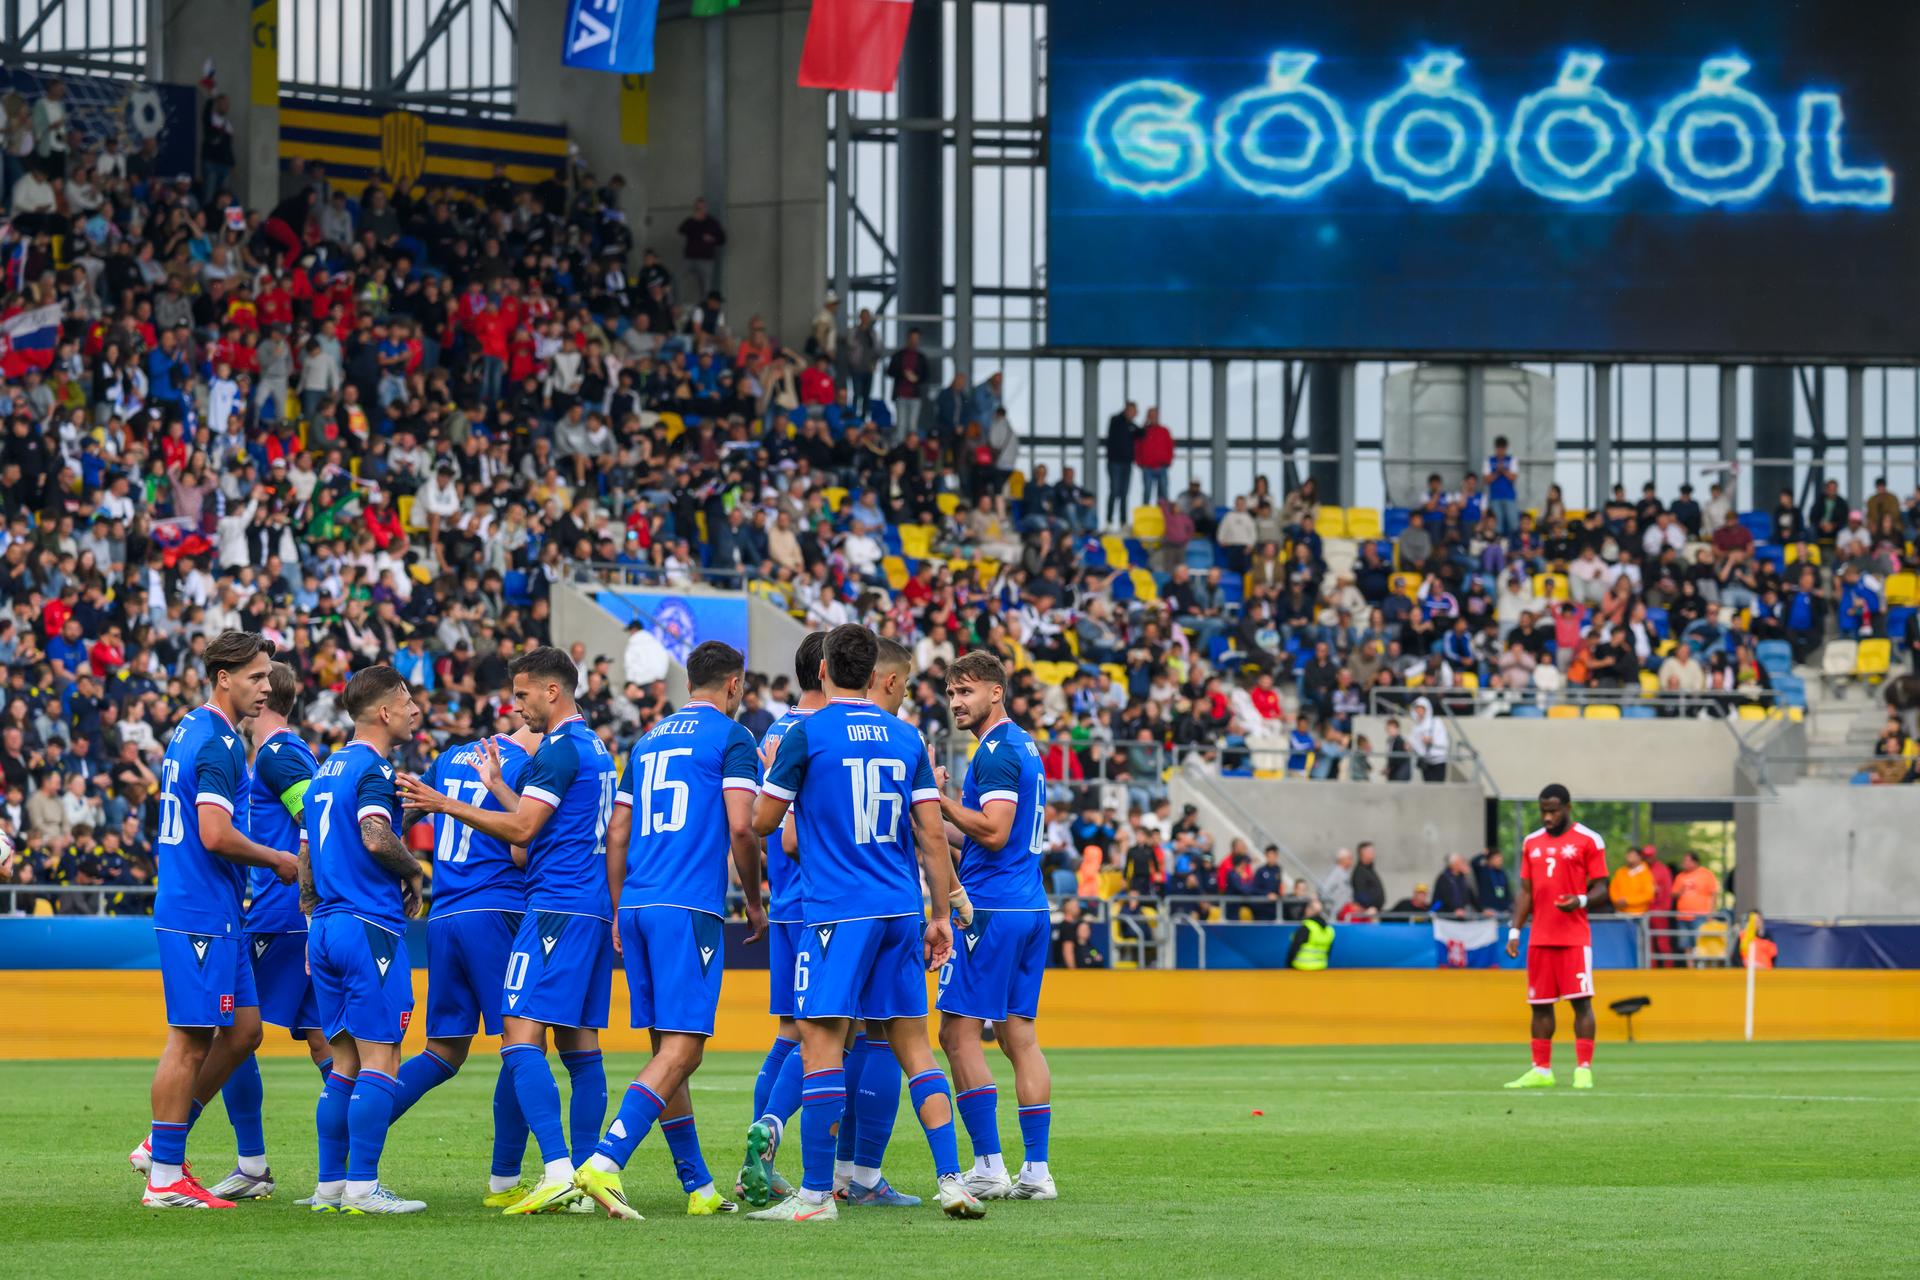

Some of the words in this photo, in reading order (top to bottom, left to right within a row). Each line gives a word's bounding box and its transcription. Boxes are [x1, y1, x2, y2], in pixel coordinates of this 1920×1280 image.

[1084, 48, 1895, 207] GÓÓÓÓL
[847, 725, 889, 742] OBERT
[315, 791, 333, 852] 7
[437, 777, 489, 863] 17
[640, 747, 693, 837] 15
[842, 758, 906, 844] 16
[1545, 857, 1557, 878] 7
[503, 951, 530, 991] 10
